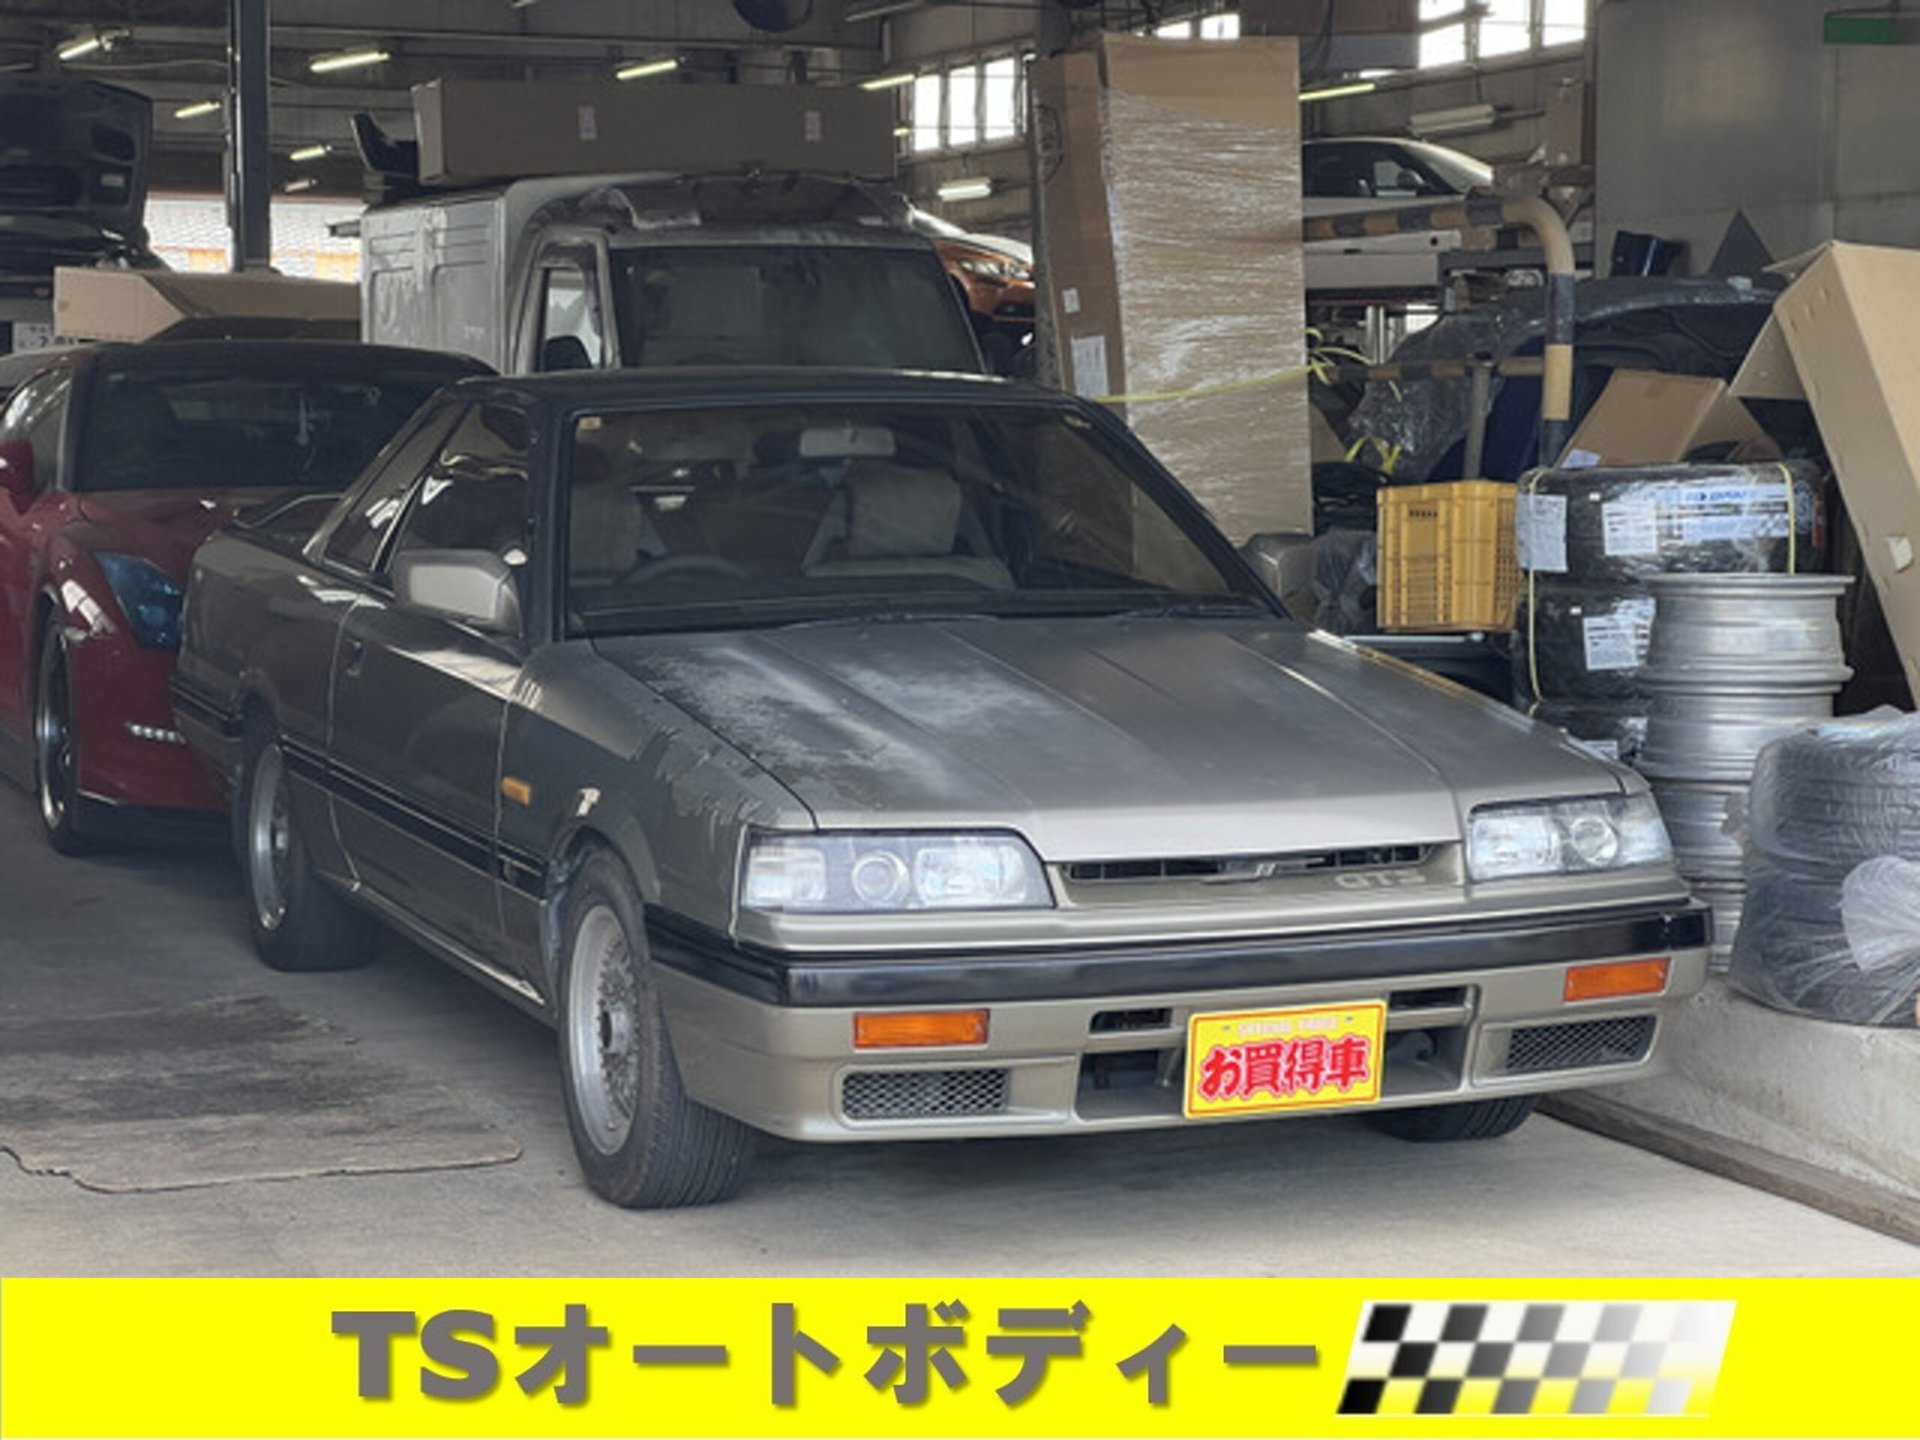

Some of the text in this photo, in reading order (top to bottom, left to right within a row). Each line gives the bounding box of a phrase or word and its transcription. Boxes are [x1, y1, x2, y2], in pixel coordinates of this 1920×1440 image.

[1335, 868, 1426, 890] GTS
[1201, 1037, 1367, 1098] お買得車
